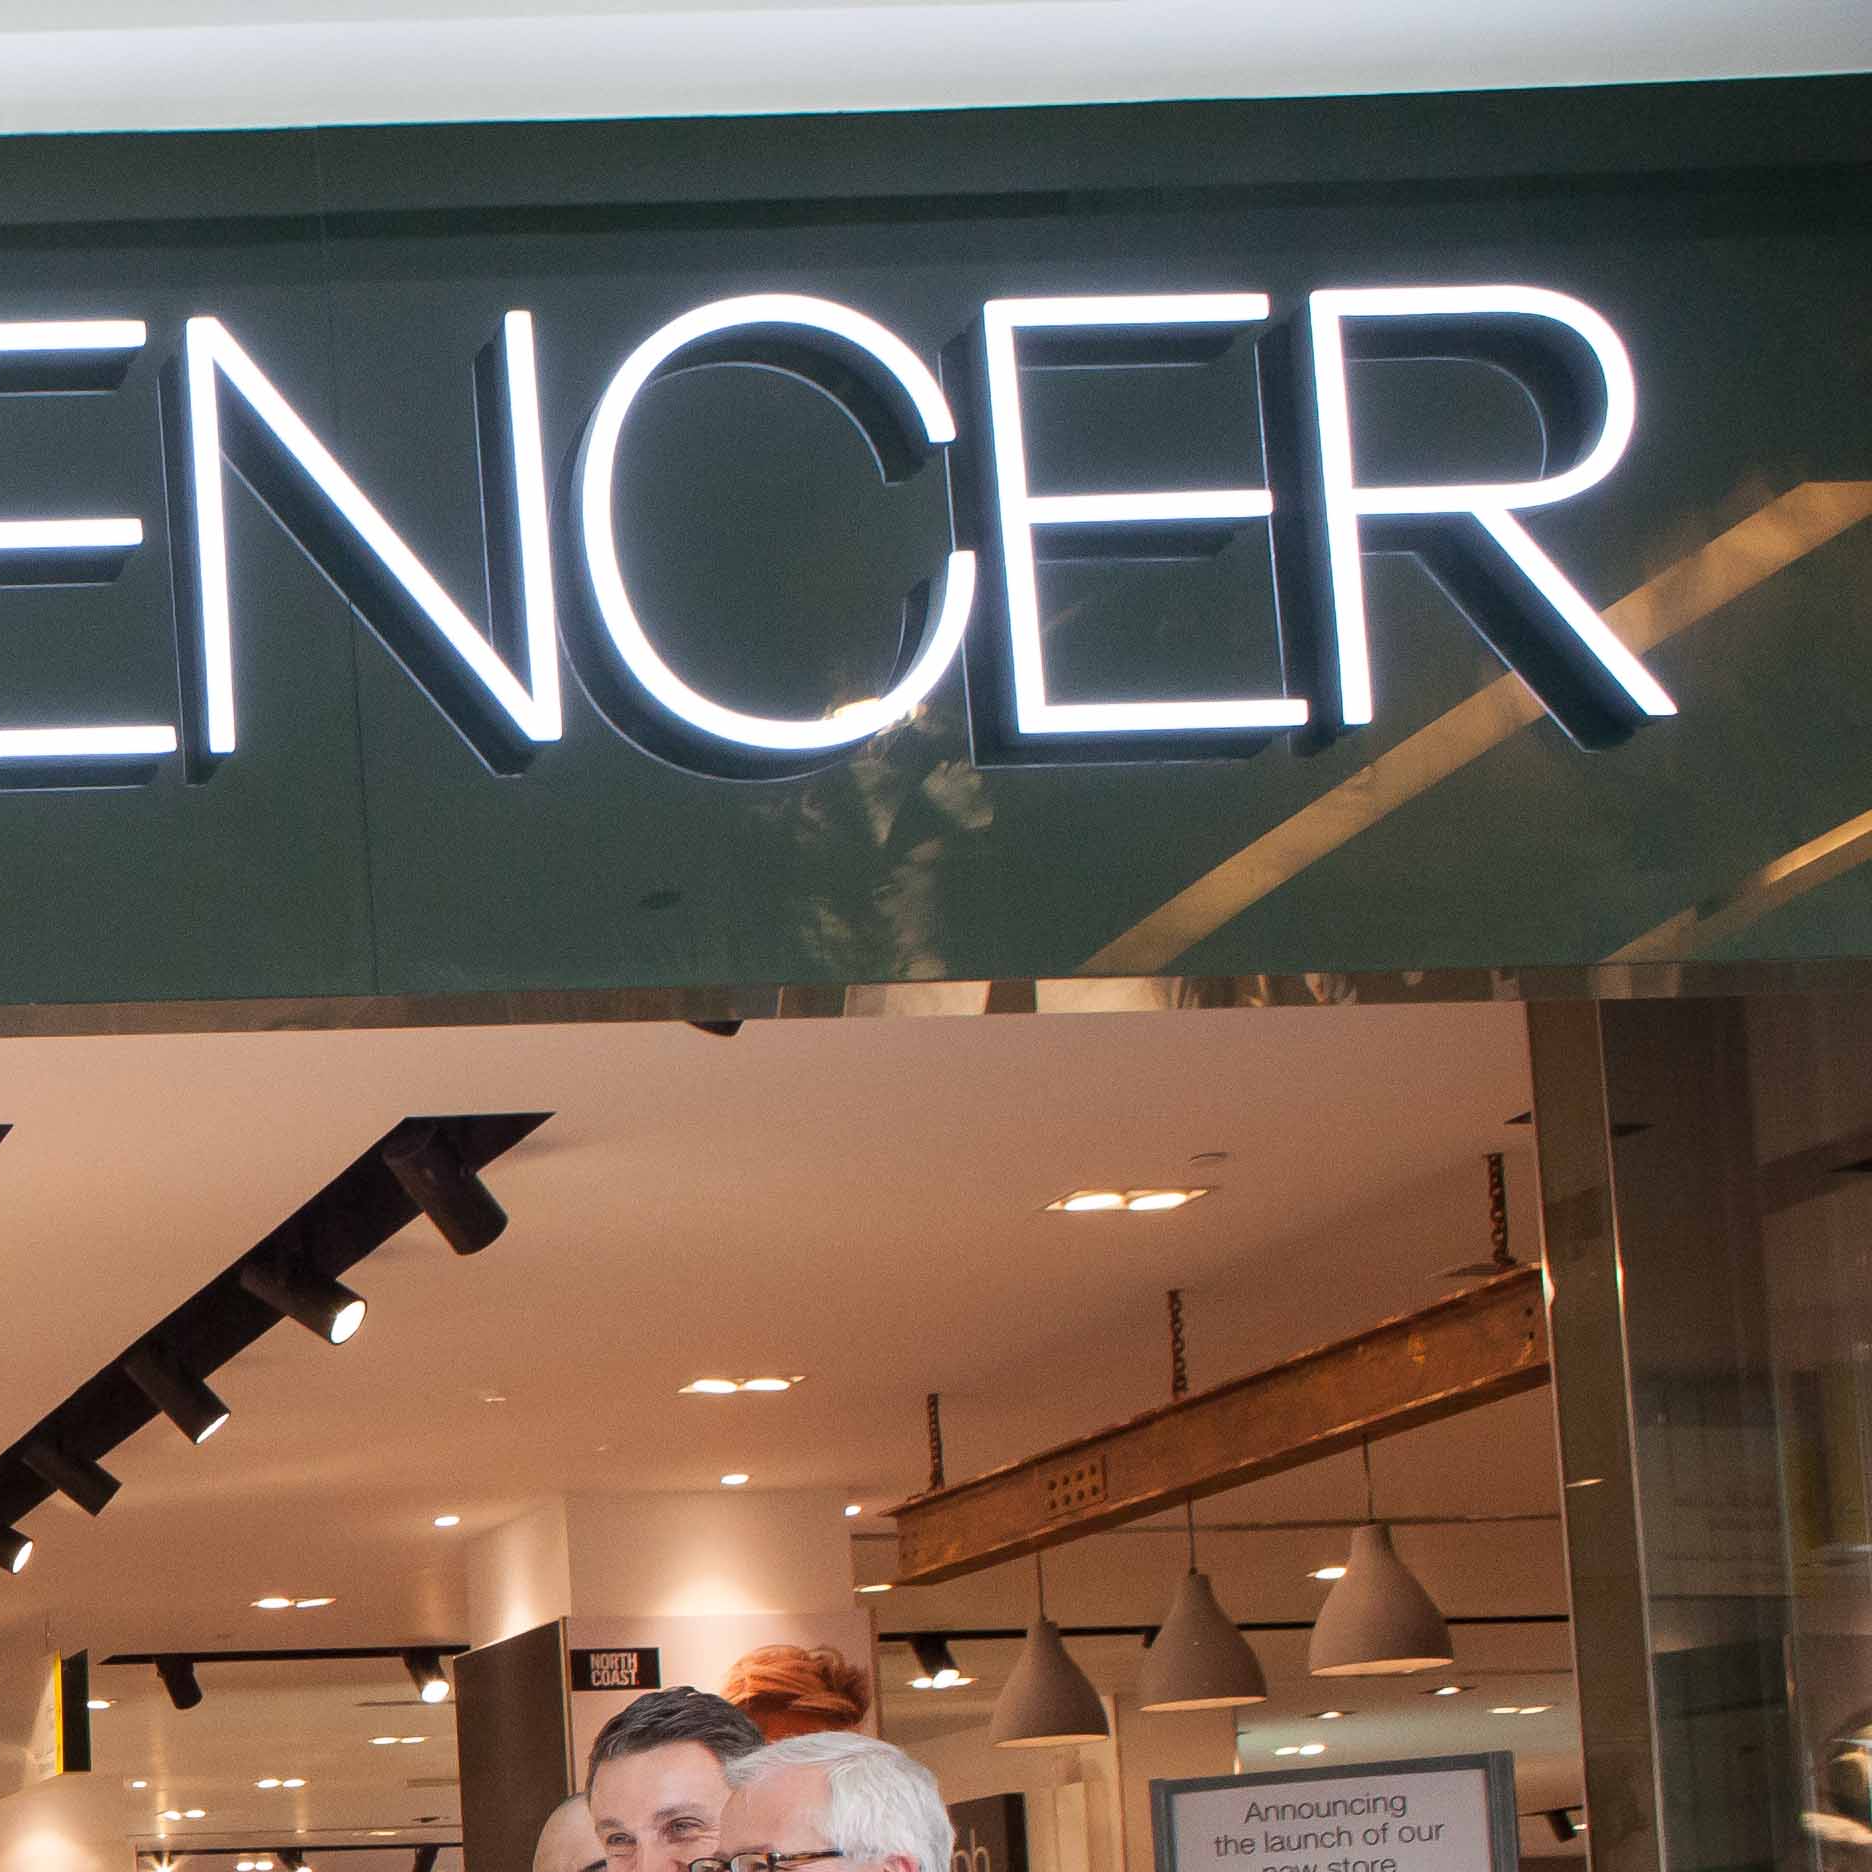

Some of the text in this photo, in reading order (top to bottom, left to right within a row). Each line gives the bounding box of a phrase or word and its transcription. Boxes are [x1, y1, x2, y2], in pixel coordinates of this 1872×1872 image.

[590, 1652, 639, 1671] NORTH
[1244, 1793, 1408, 1825] Announcing
[1215, 1822, 1445, 1857] the launch of our
